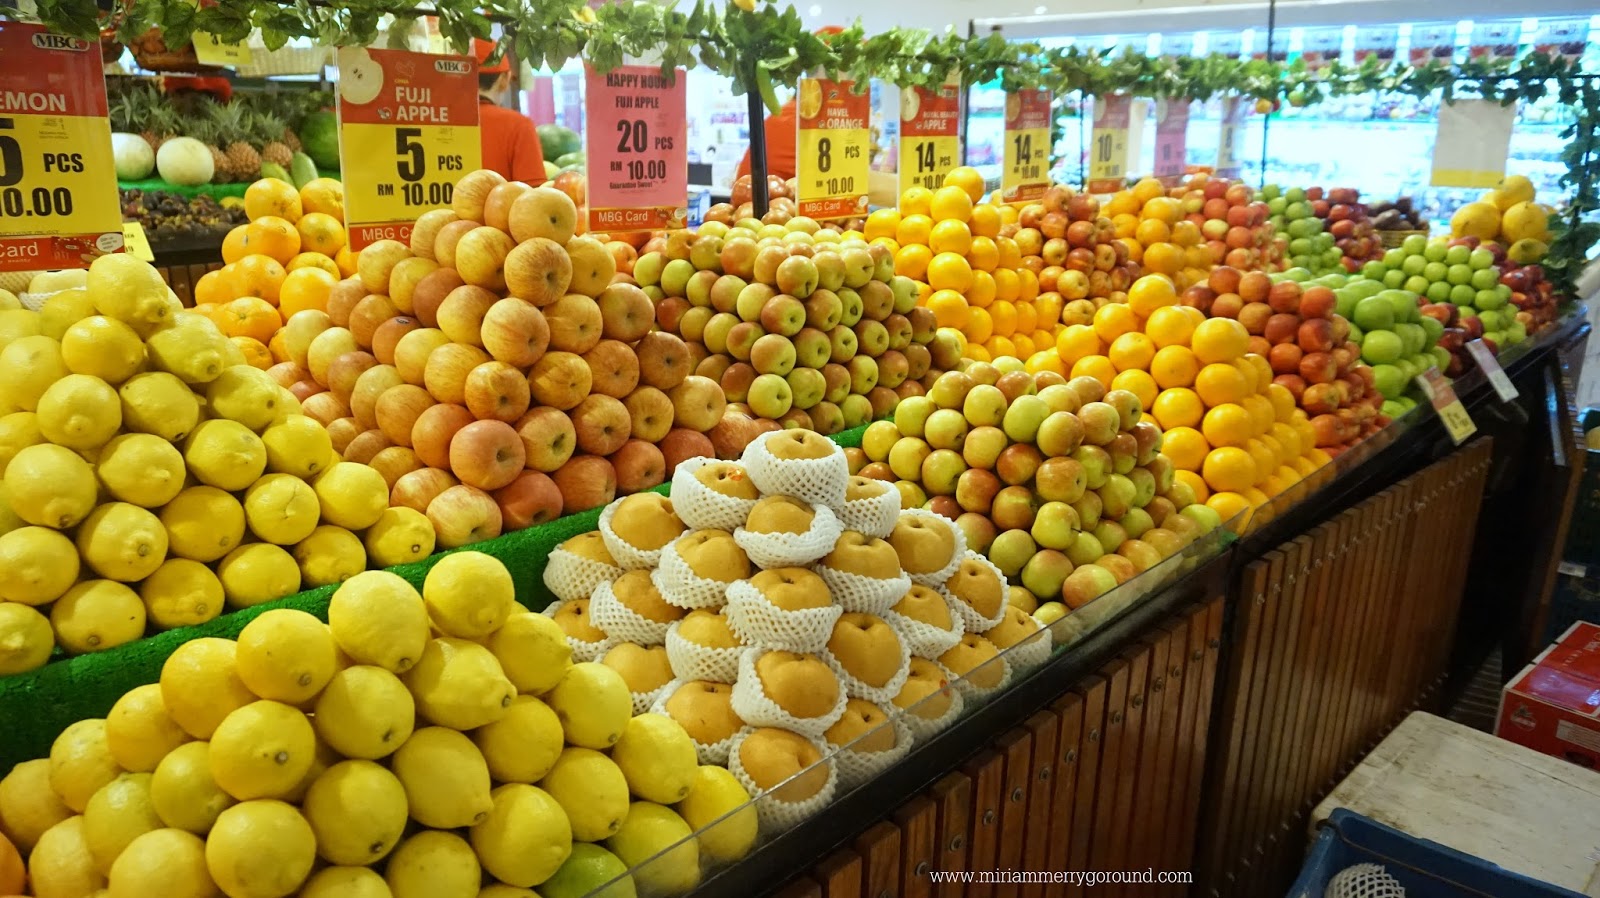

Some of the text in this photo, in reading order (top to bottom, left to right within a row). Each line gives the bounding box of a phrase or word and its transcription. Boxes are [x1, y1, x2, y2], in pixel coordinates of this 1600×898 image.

[606, 73, 638, 87] HAPPY
[395, 87, 431, 103] FUJI
[615, 96, 659, 109] FUJI APPLE
[396, 106, 449, 122] APPLE
[827, 107, 849, 116] NAVEL
[827, 118, 863, 129] ORANGE
[923, 120, 947, 130] APPLE
[616, 119, 648, 153] 20
[655, 136, 673, 150] PCS
[395, 128, 426, 182] 5
[437, 155, 463, 171] PCS
[817, 137, 860, 173] 8 PCS
[1014, 134, 1031, 165] 14
[1098, 133, 1112, 162] 10
[43, 153, 84, 173] PCS
[915, 142, 951, 173] 14 PCS
[610, 159, 666, 180] RM 10.00
[377, 182, 454, 206] RM 10.00
[826, 176, 854, 195] 10.00
[0, 187, 73, 218] 0.00
[805, 201, 841, 213] MBG Card
[598, 210, 648, 223] MBG Card
[362, 226, 395, 242] MBG
